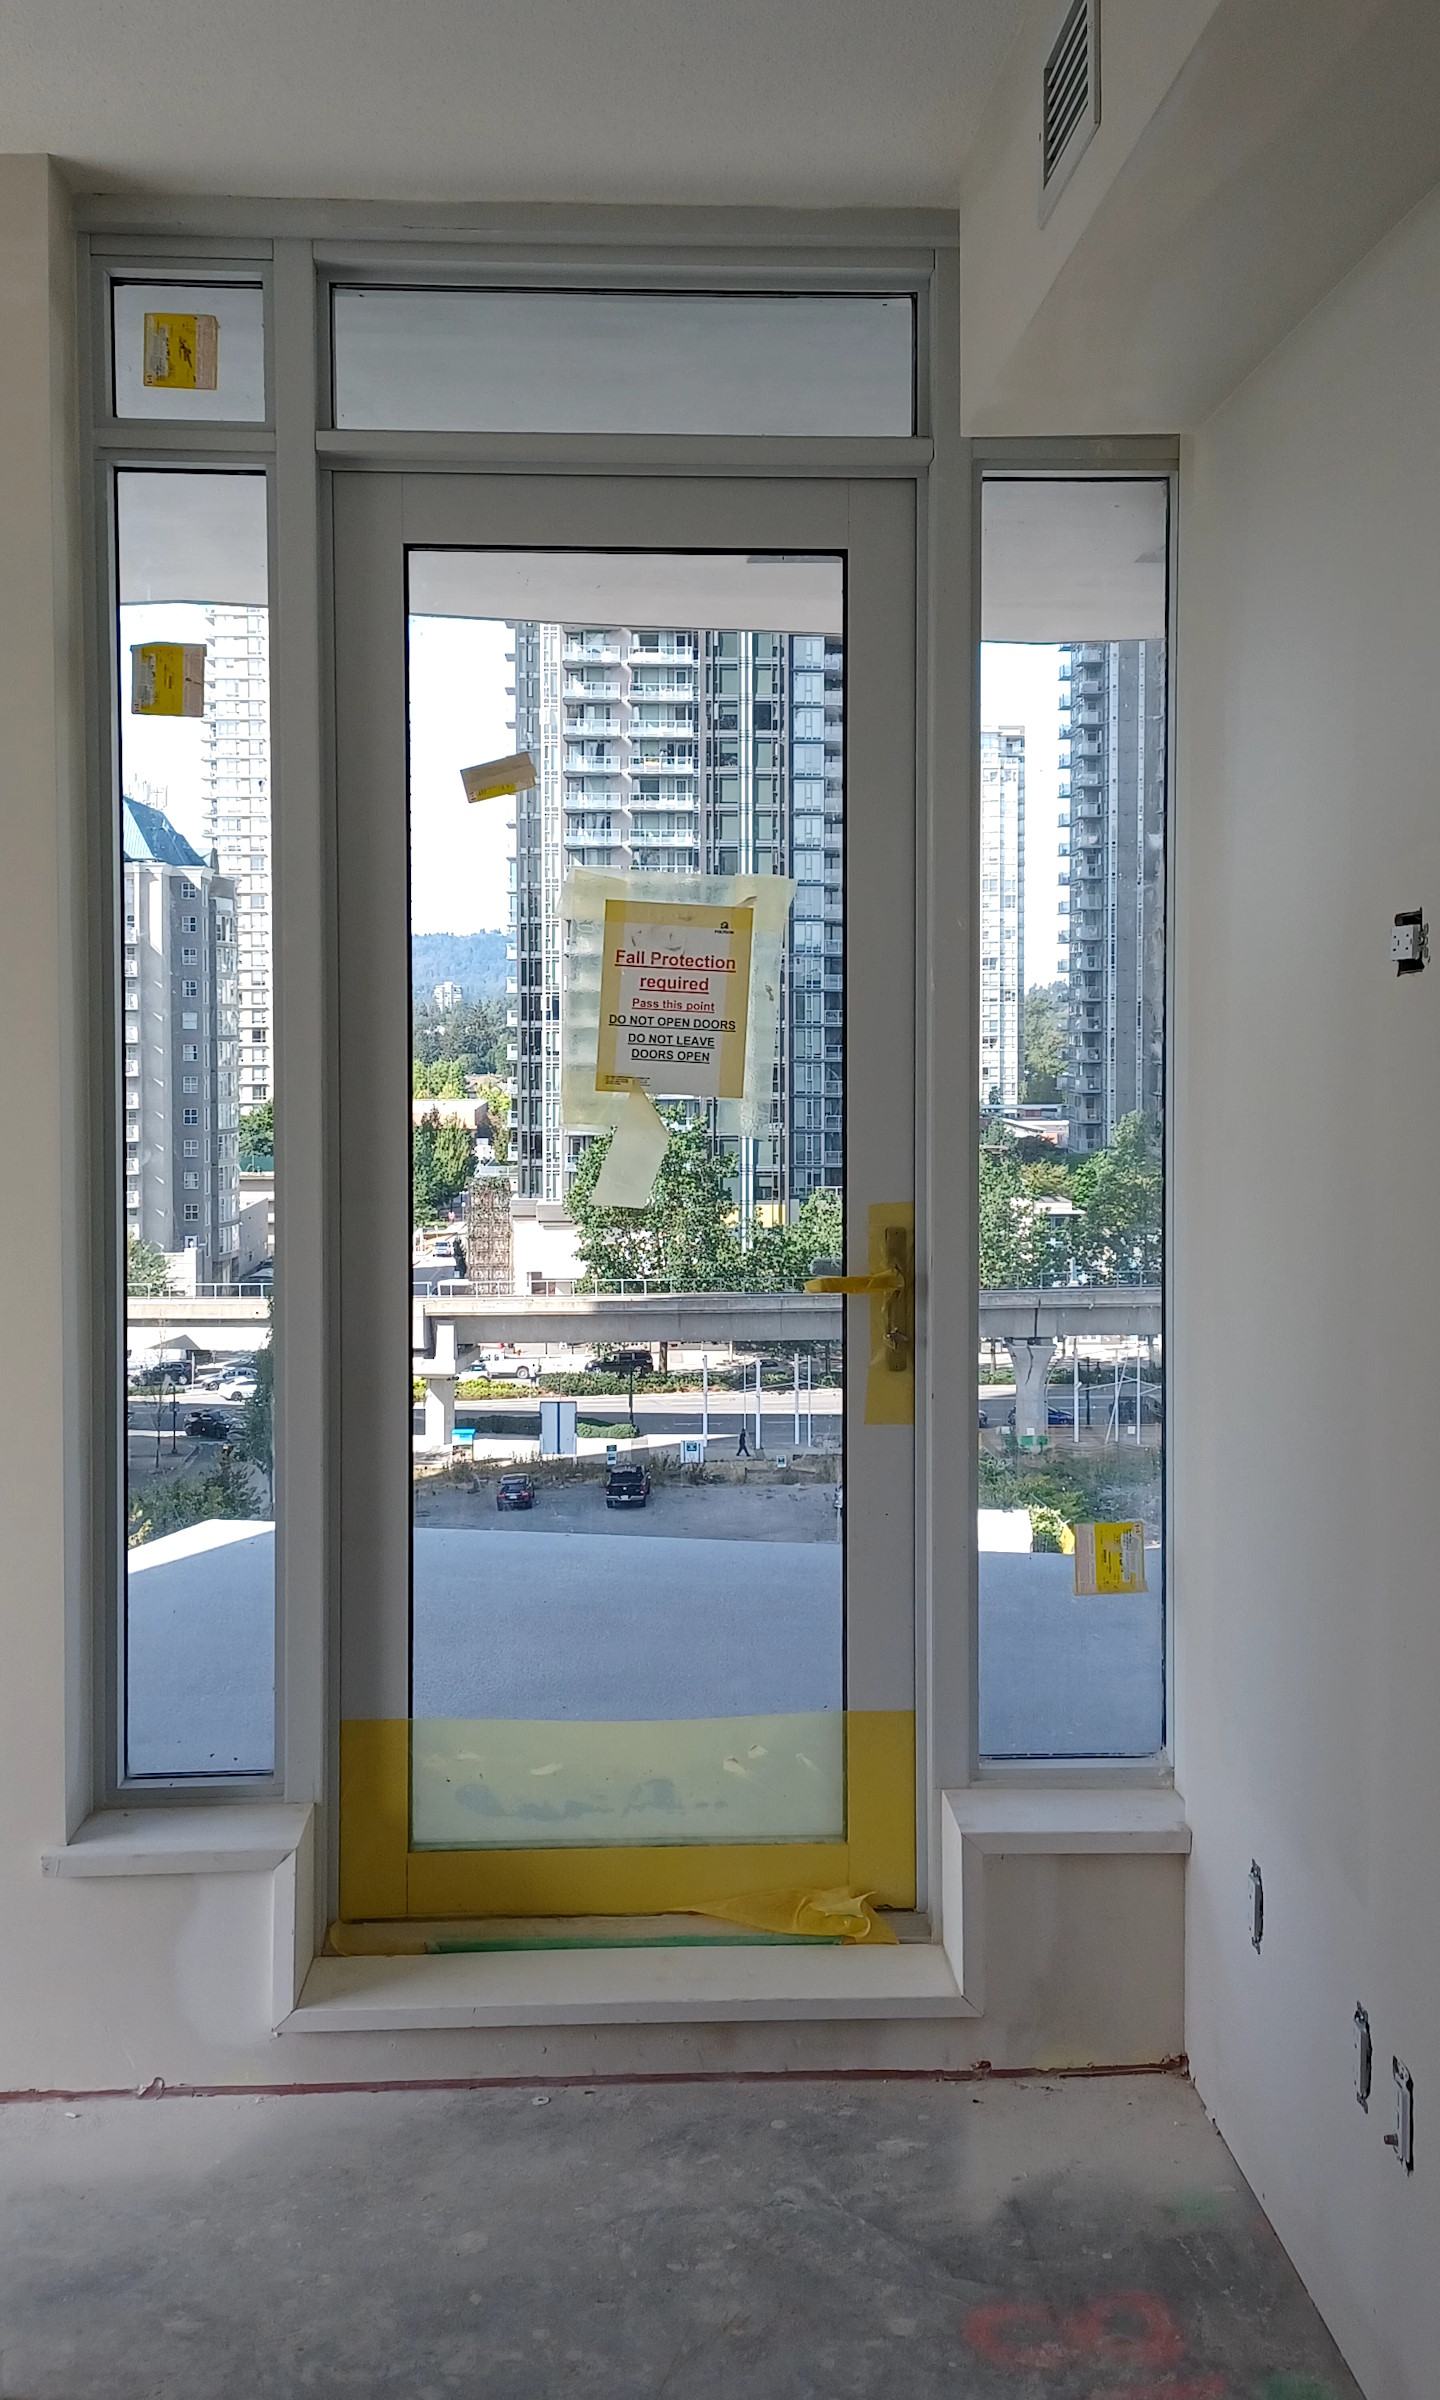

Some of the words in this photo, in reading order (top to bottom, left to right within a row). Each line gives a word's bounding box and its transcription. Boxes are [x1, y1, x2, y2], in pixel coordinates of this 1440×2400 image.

[615, 949, 645, 965] Fall
[651, 951, 736, 970] Protection
[640, 976, 709, 992] required
[632, 998, 659, 1009] Pass
[662, 999, 683, 1010] this
[686, 1001, 715, 1012] point
[609, 1014, 626, 1025] DO
[629, 1015, 654, 1026] NOT
[657, 1016, 690, 1028] OPEN
[693, 1018, 736, 1030] DOORS
[628, 1033, 646, 1043] DO
[648, 1033, 674, 1045] NOT
[676, 1035, 715, 1047] LEAVE
[631, 1048, 674, 1060] DOORS
[677, 1050, 710, 1062] OPEN
